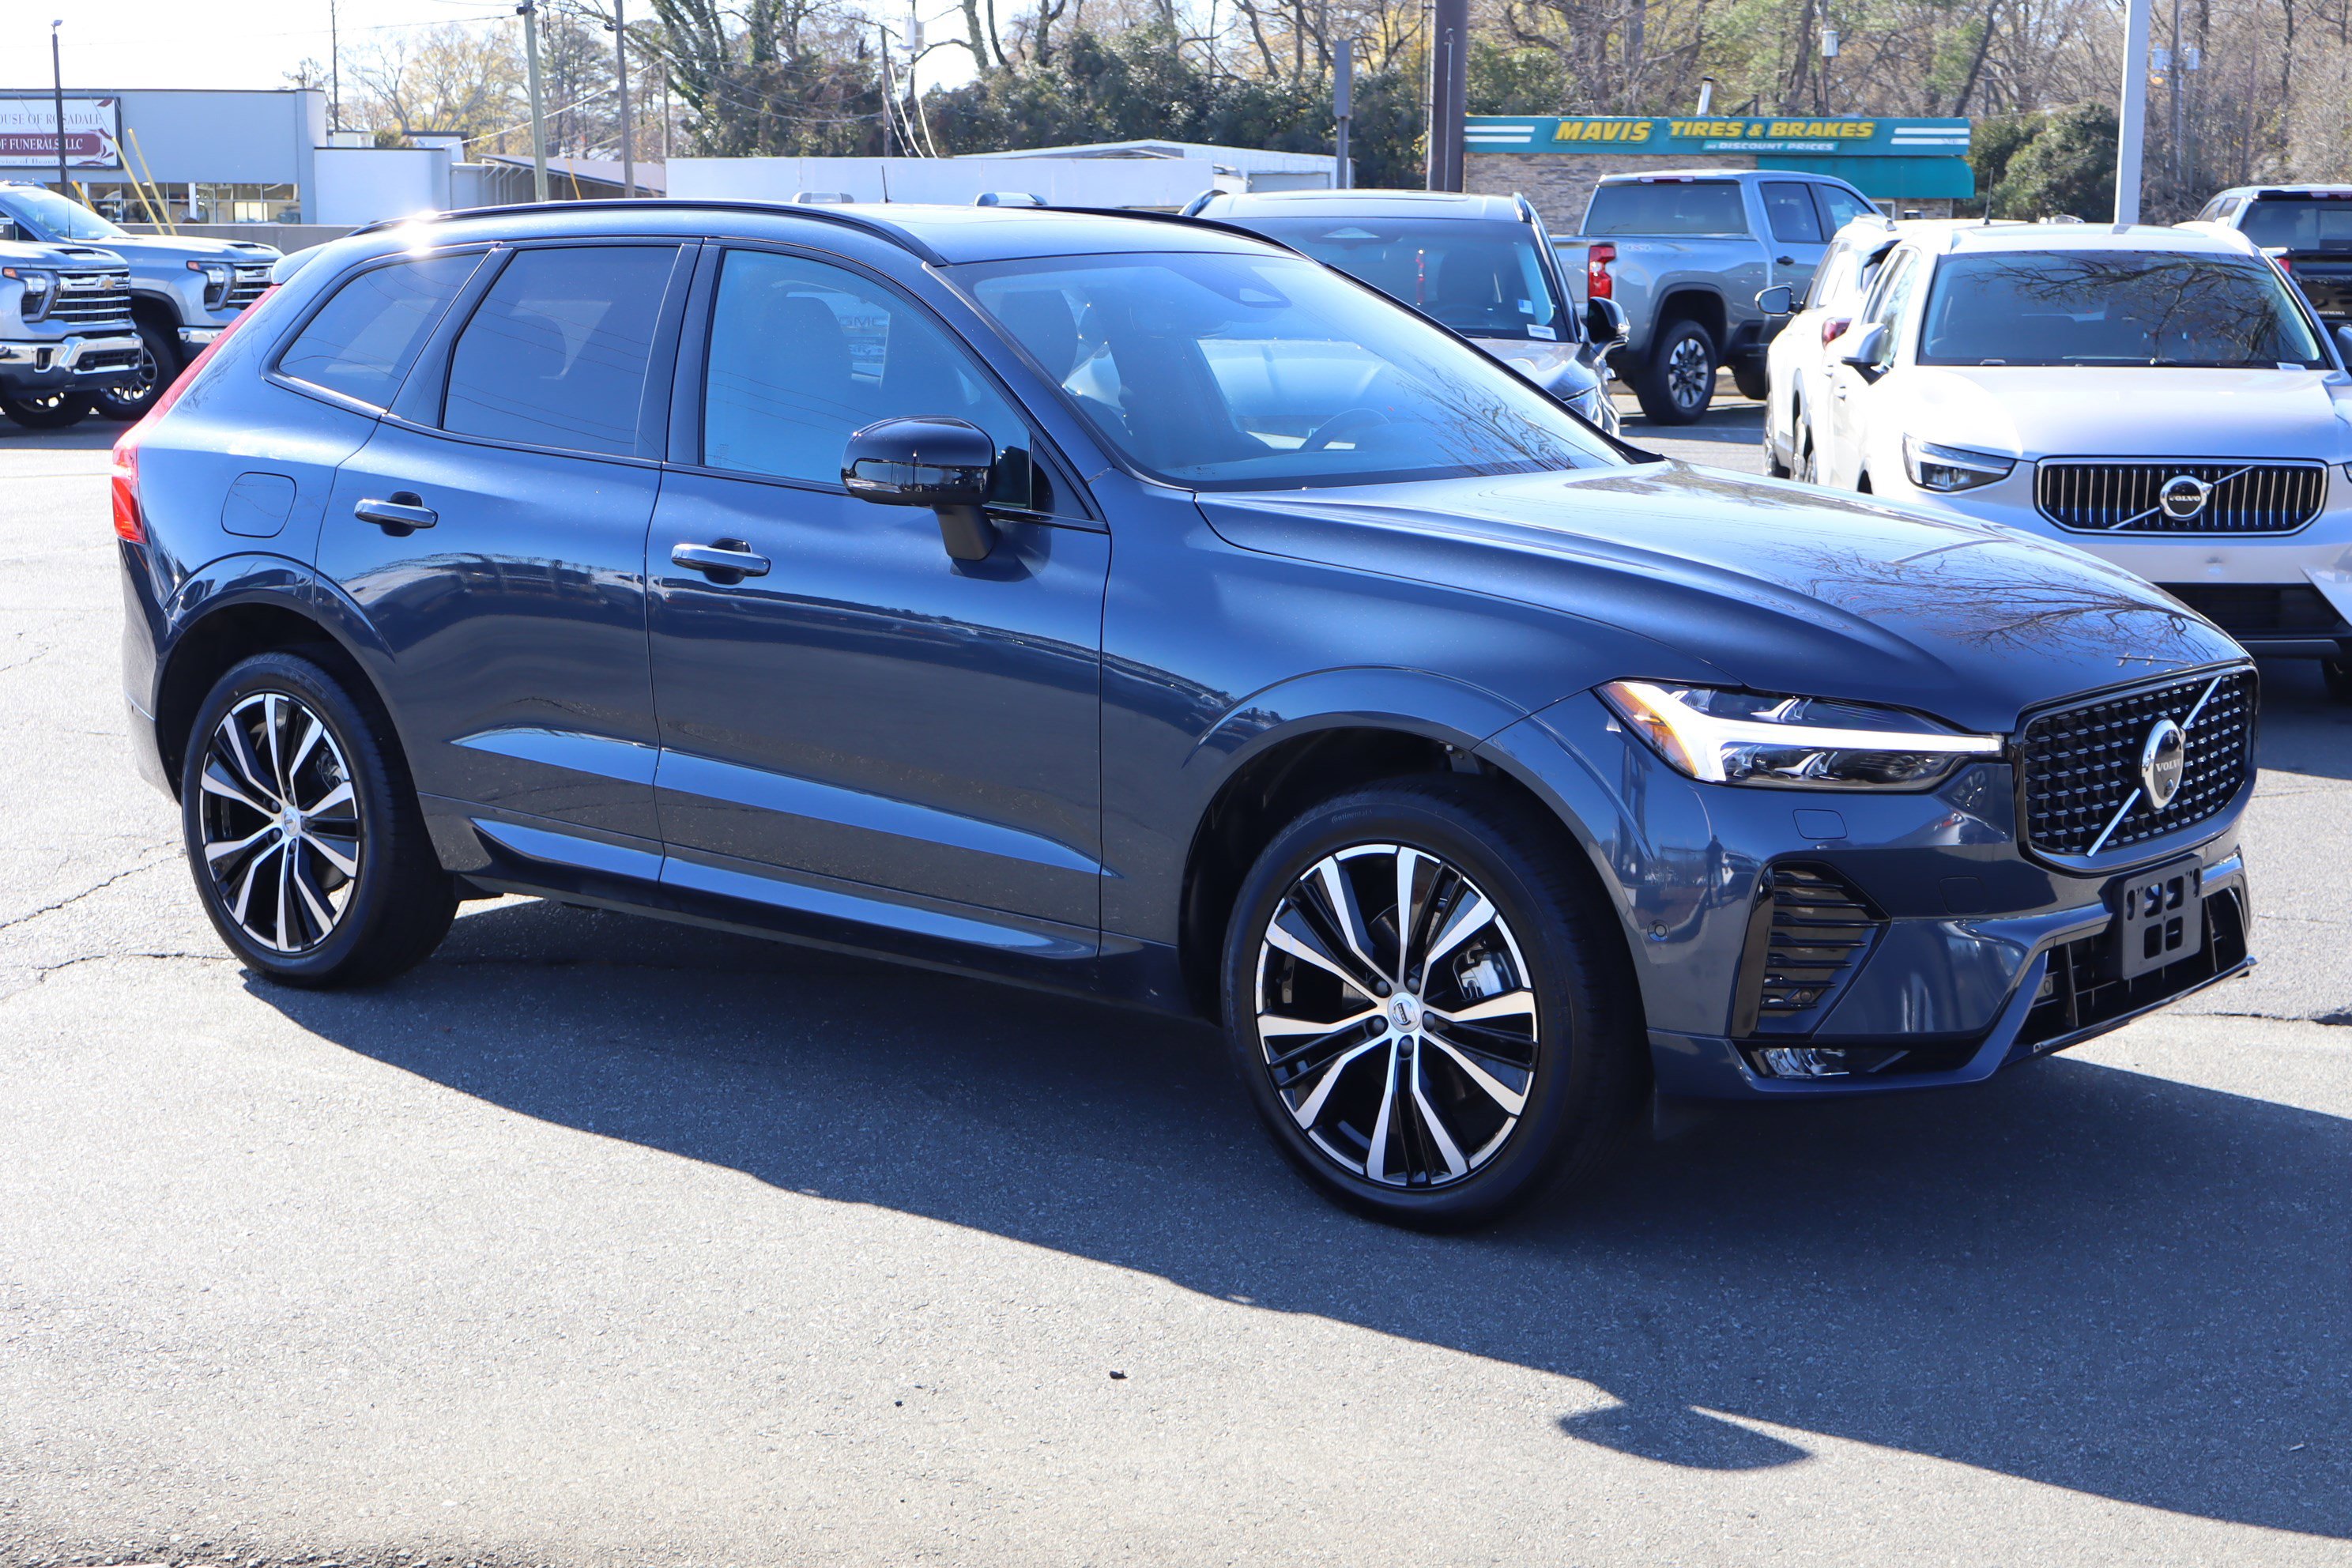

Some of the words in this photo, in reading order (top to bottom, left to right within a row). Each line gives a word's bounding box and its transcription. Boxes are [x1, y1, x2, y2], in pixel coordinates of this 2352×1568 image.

[28, 113, 43, 125] OF
[1555, 120, 1653, 141] MAVIS
[1668, 120, 1743, 138] TIRES
[1747, 123, 1764, 137] &
[1769, 121, 1875, 138] BRAKES
[9, 138, 59, 150] FUNERALS
[65, 138, 83, 150] LLC
[1718, 141, 1783, 150] DISCOUNT
[1786, 142, 1834, 151] PRICES
[2155, 758, 2181, 772] VOLV
